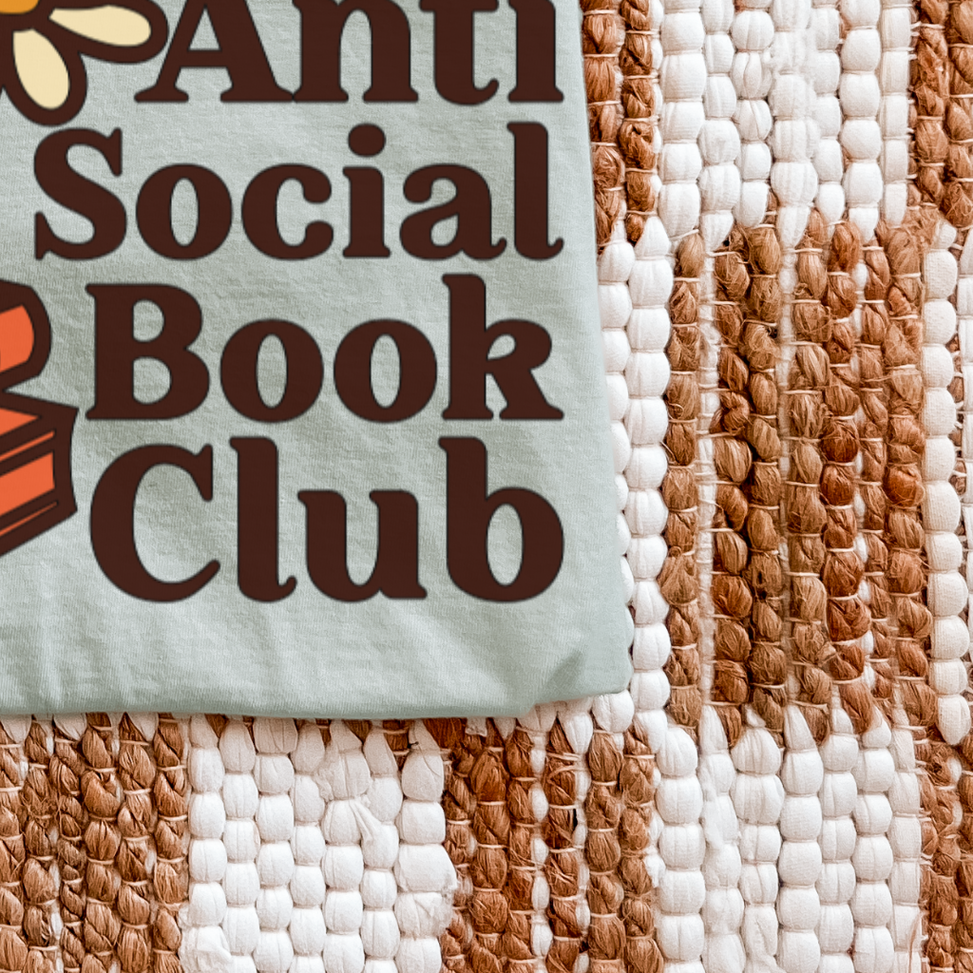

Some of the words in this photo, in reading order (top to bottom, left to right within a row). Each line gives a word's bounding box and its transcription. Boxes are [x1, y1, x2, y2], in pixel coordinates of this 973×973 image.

[33, 122, 564, 260] Social
[85, 274, 564, 423] Book
[89, 436, 565, 603] Club
